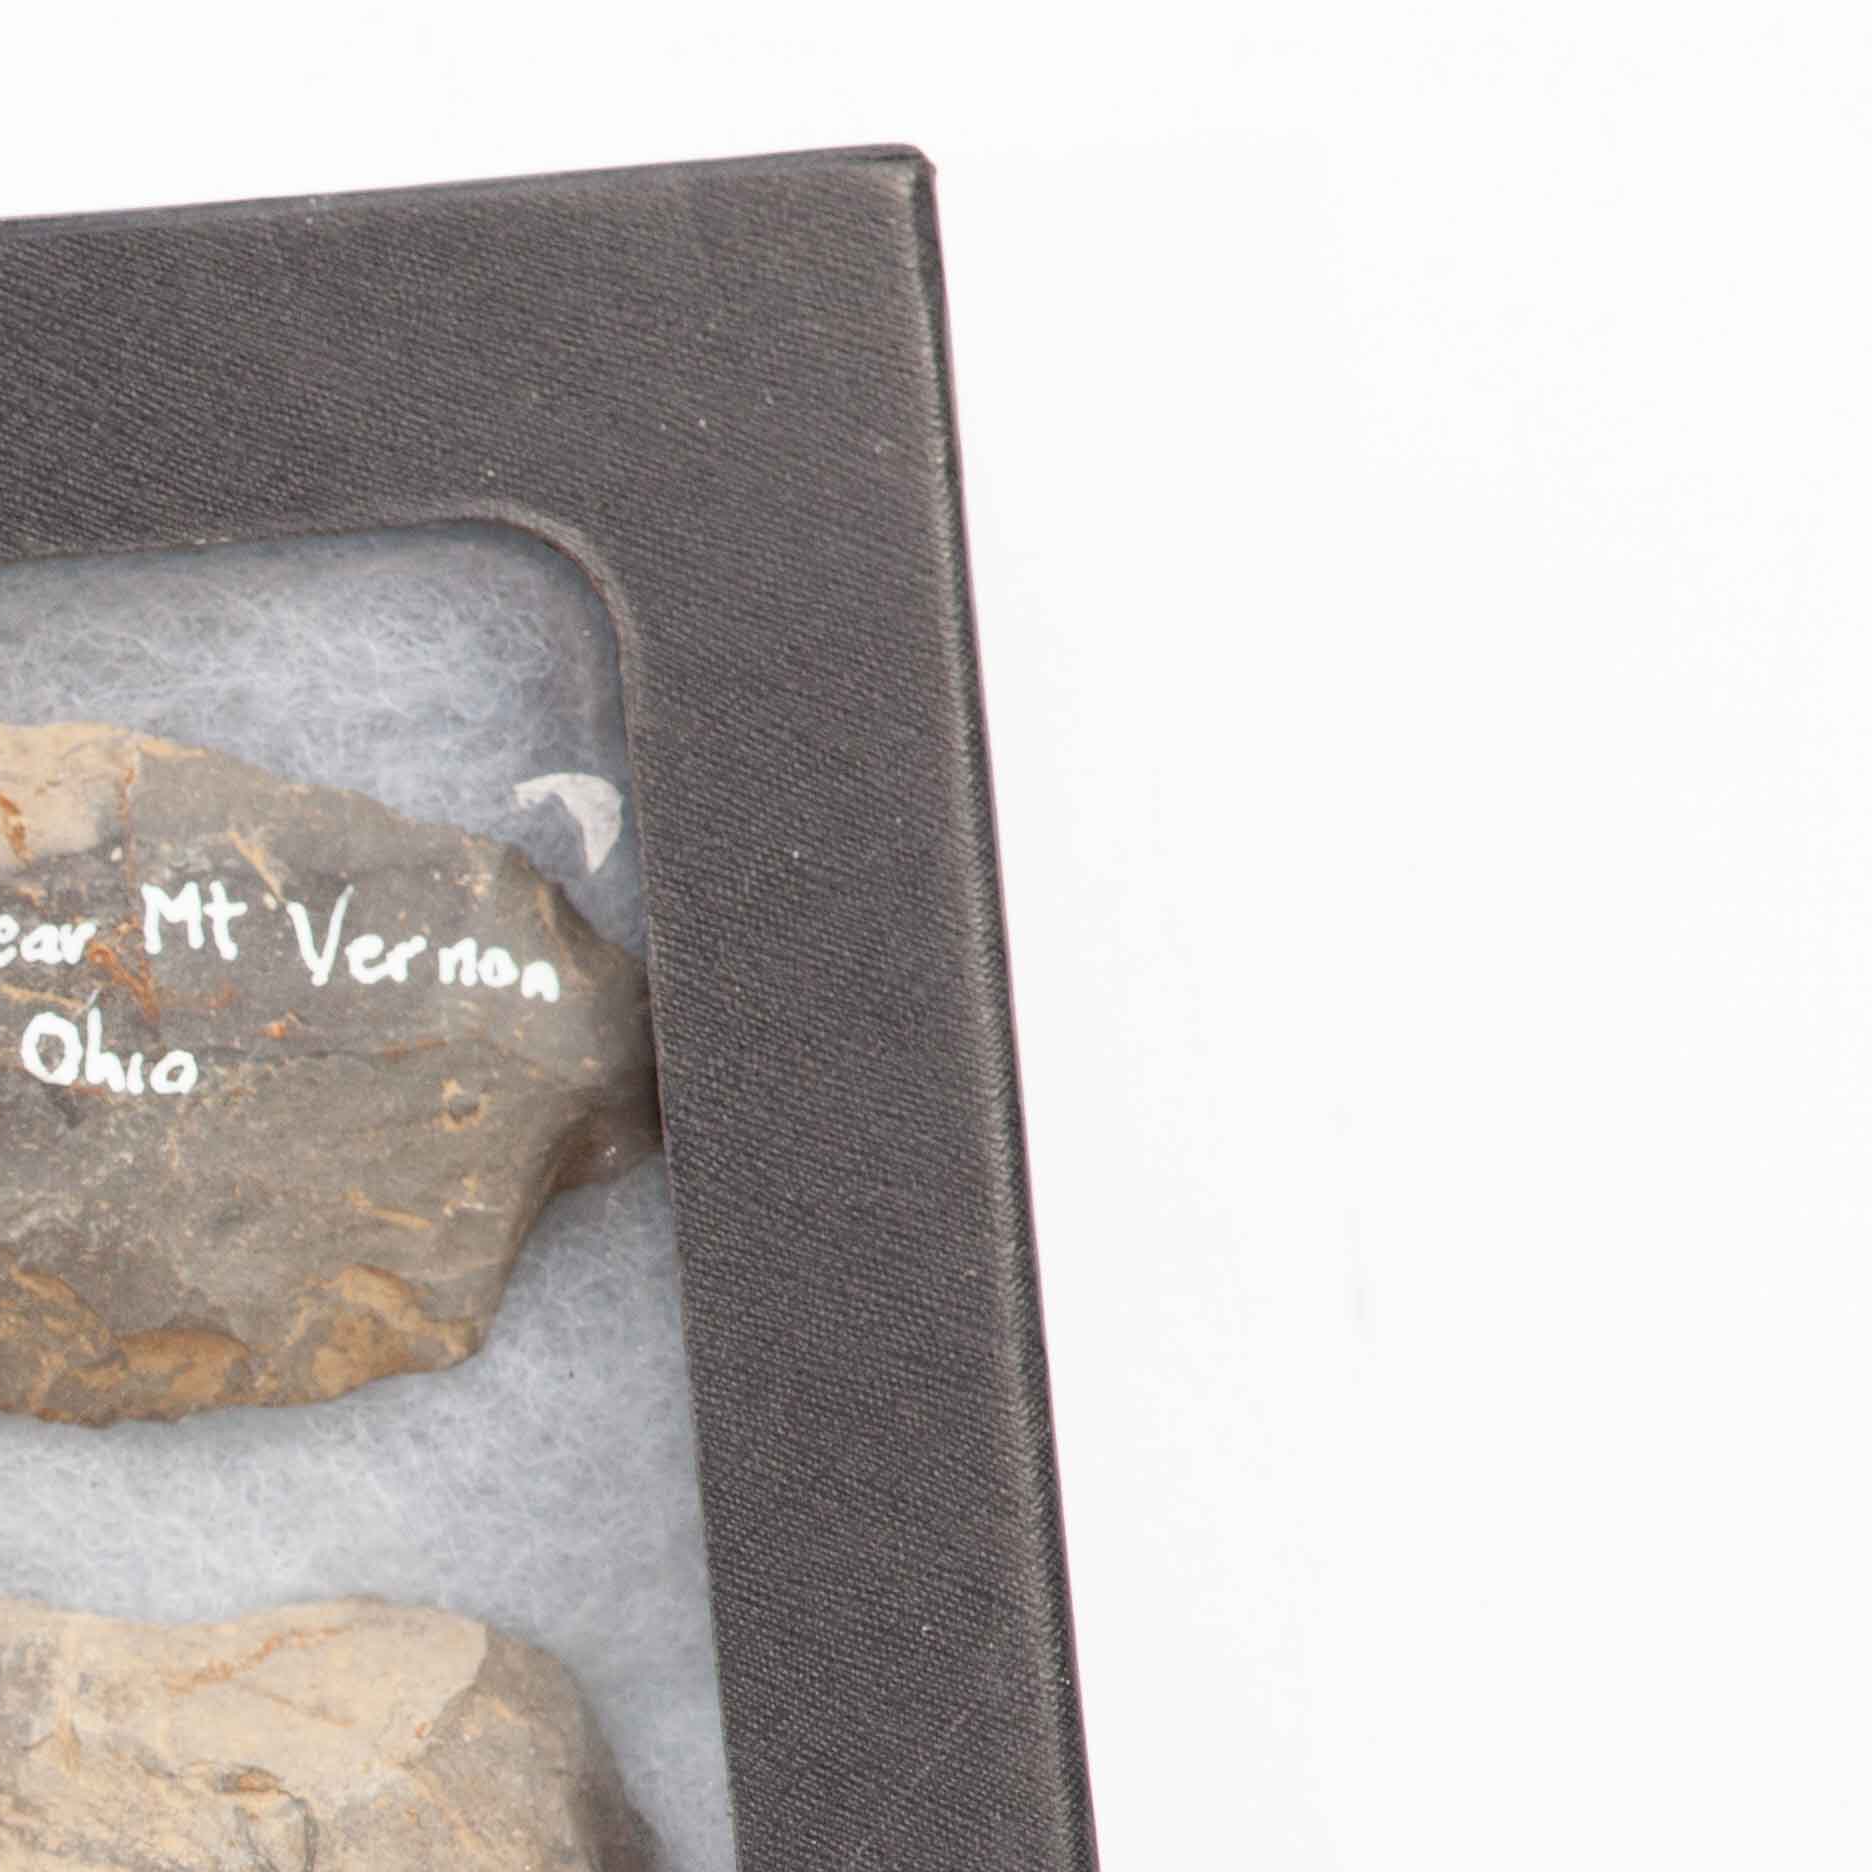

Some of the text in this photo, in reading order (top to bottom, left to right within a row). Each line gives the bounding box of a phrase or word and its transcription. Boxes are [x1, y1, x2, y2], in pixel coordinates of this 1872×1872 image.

[142, 878, 247, 961] Mt
[286, 884, 559, 1002] Vernon
[19, 988, 199, 1096] Ohio
